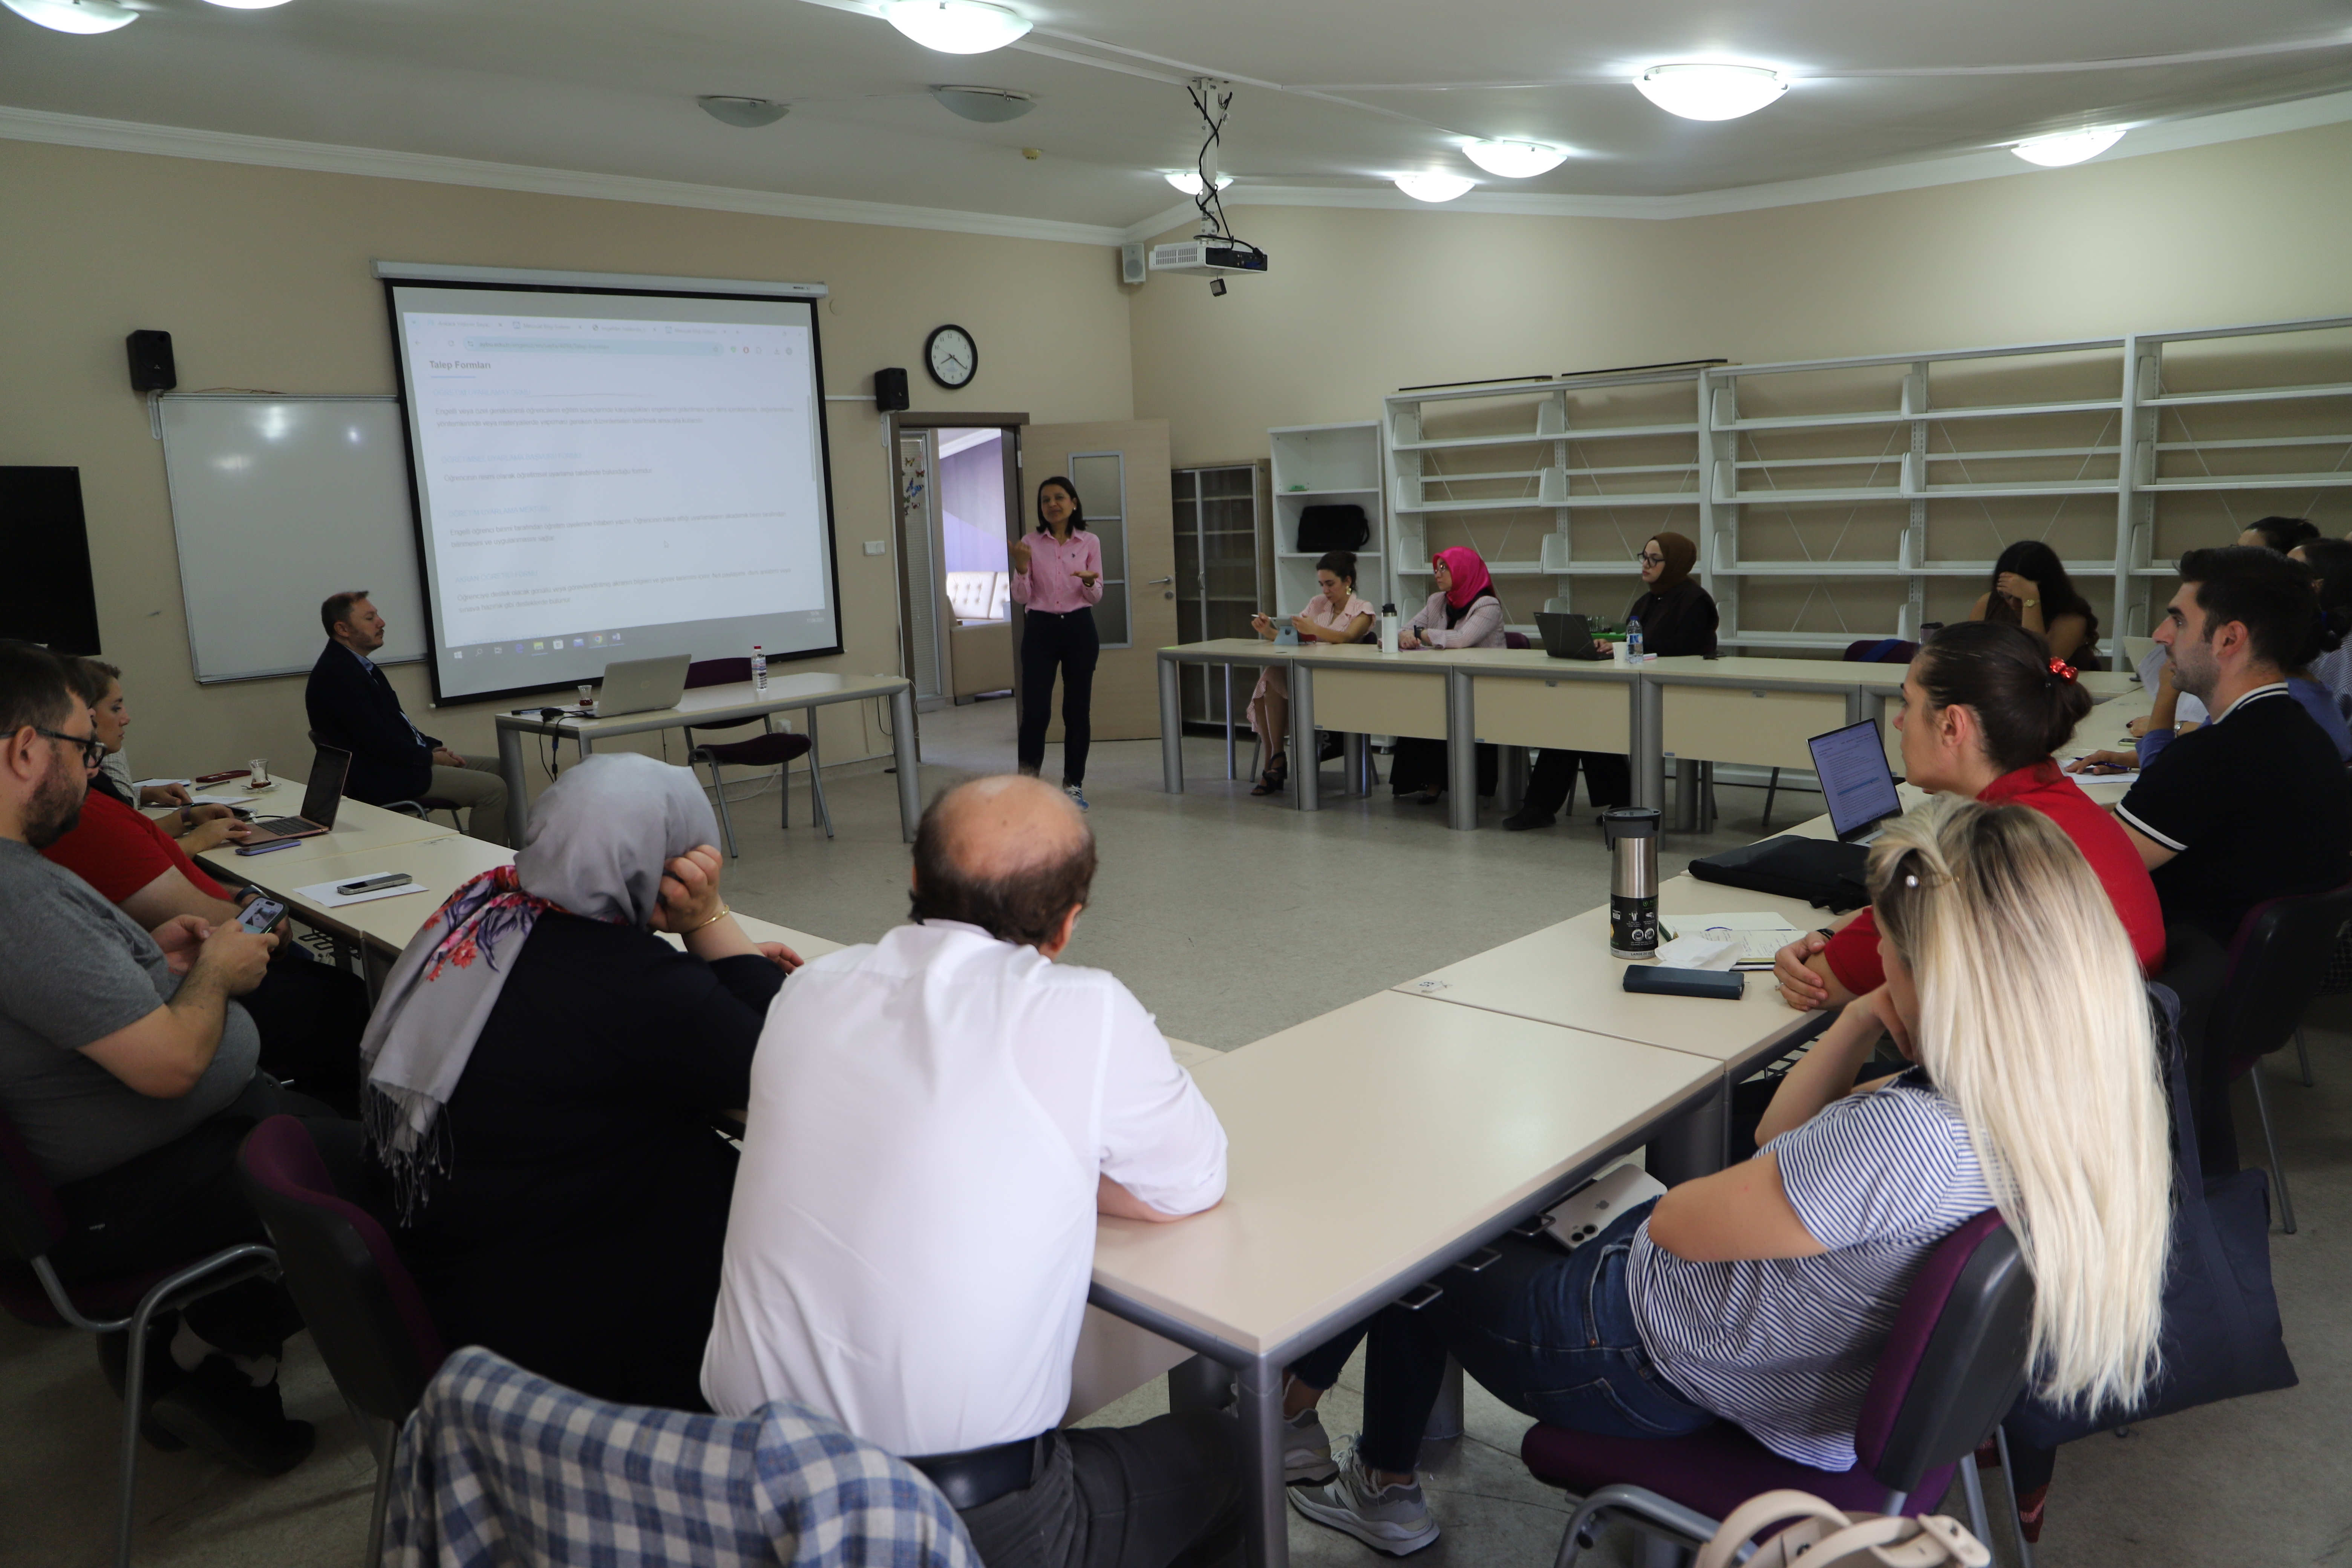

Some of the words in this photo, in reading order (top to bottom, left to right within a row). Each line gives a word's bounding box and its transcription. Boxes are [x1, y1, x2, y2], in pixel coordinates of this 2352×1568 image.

[429, 360, 452, 370] Talep
[455, 360, 491, 369] Formları
[561, 407, 579, 415] eğitim
[444, 474, 478, 483] Öğrencinin
[517, 471, 547, 479] öğretimsel
[450, 528, 471, 537] Engelli
[544, 522, 565, 531] öğretim
[567, 521, 593, 529] üyelerine
[633, 517, 662, 525] Öğrencinin
[451, 540, 483, 548] bilinmesini
[494, 536, 537, 545] uygulanmasını
[455, 575, 479, 583] AKRAN
[457, 593, 490, 602] Öğrenciye
[531, 587, 552, 595] gönüllü
[481, 602, 503, 611] hazırlık
[504, 601, 514, 609] gibi
[515, 599, 548, 608] desteklerde
